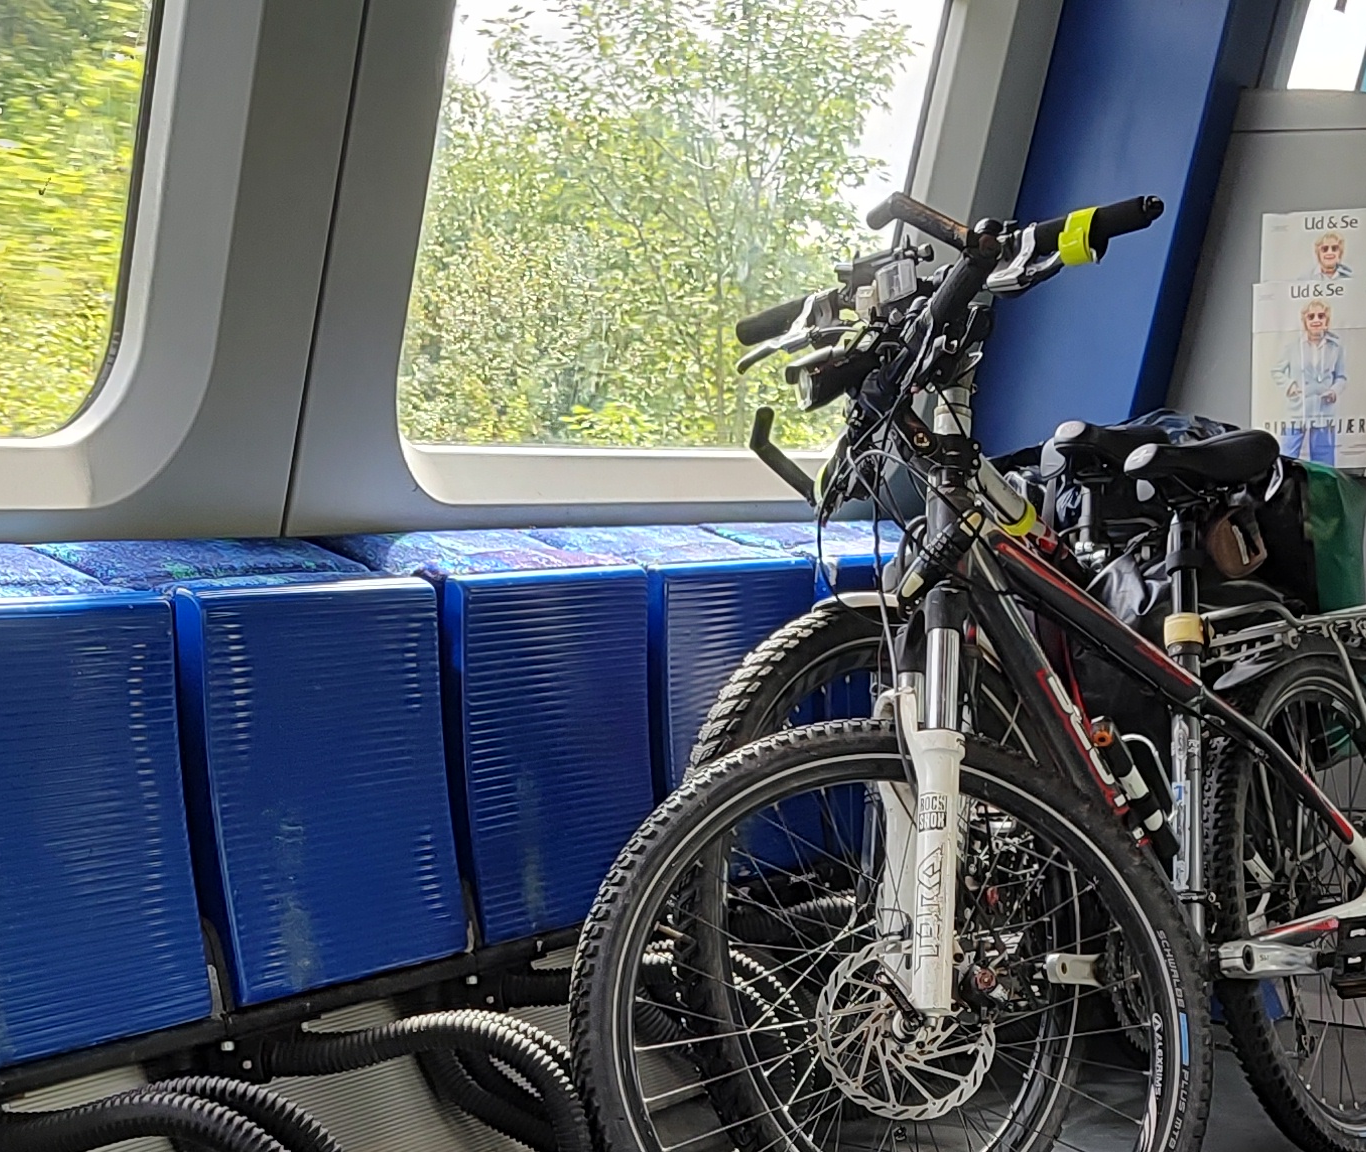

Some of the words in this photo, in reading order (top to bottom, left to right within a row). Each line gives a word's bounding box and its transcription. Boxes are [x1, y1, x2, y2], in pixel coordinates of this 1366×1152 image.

[1304, 216, 1324, 230] Ud
[1326, 216, 1338, 229] &
[1340, 215, 1359, 229] Se
[1290, 285, 1310, 299] Ud
[1312, 284, 1323, 297] &
[1325, 283, 1344, 297] Se
[920, 795, 945, 812] ROCK
[919, 812, 946, 831] SHOX
[1156, 929, 1186, 1009] SCHWALBE
[1178, 1067, 1191, 1115] PLUS
[1168, 1117, 1184, 1150] MTB
